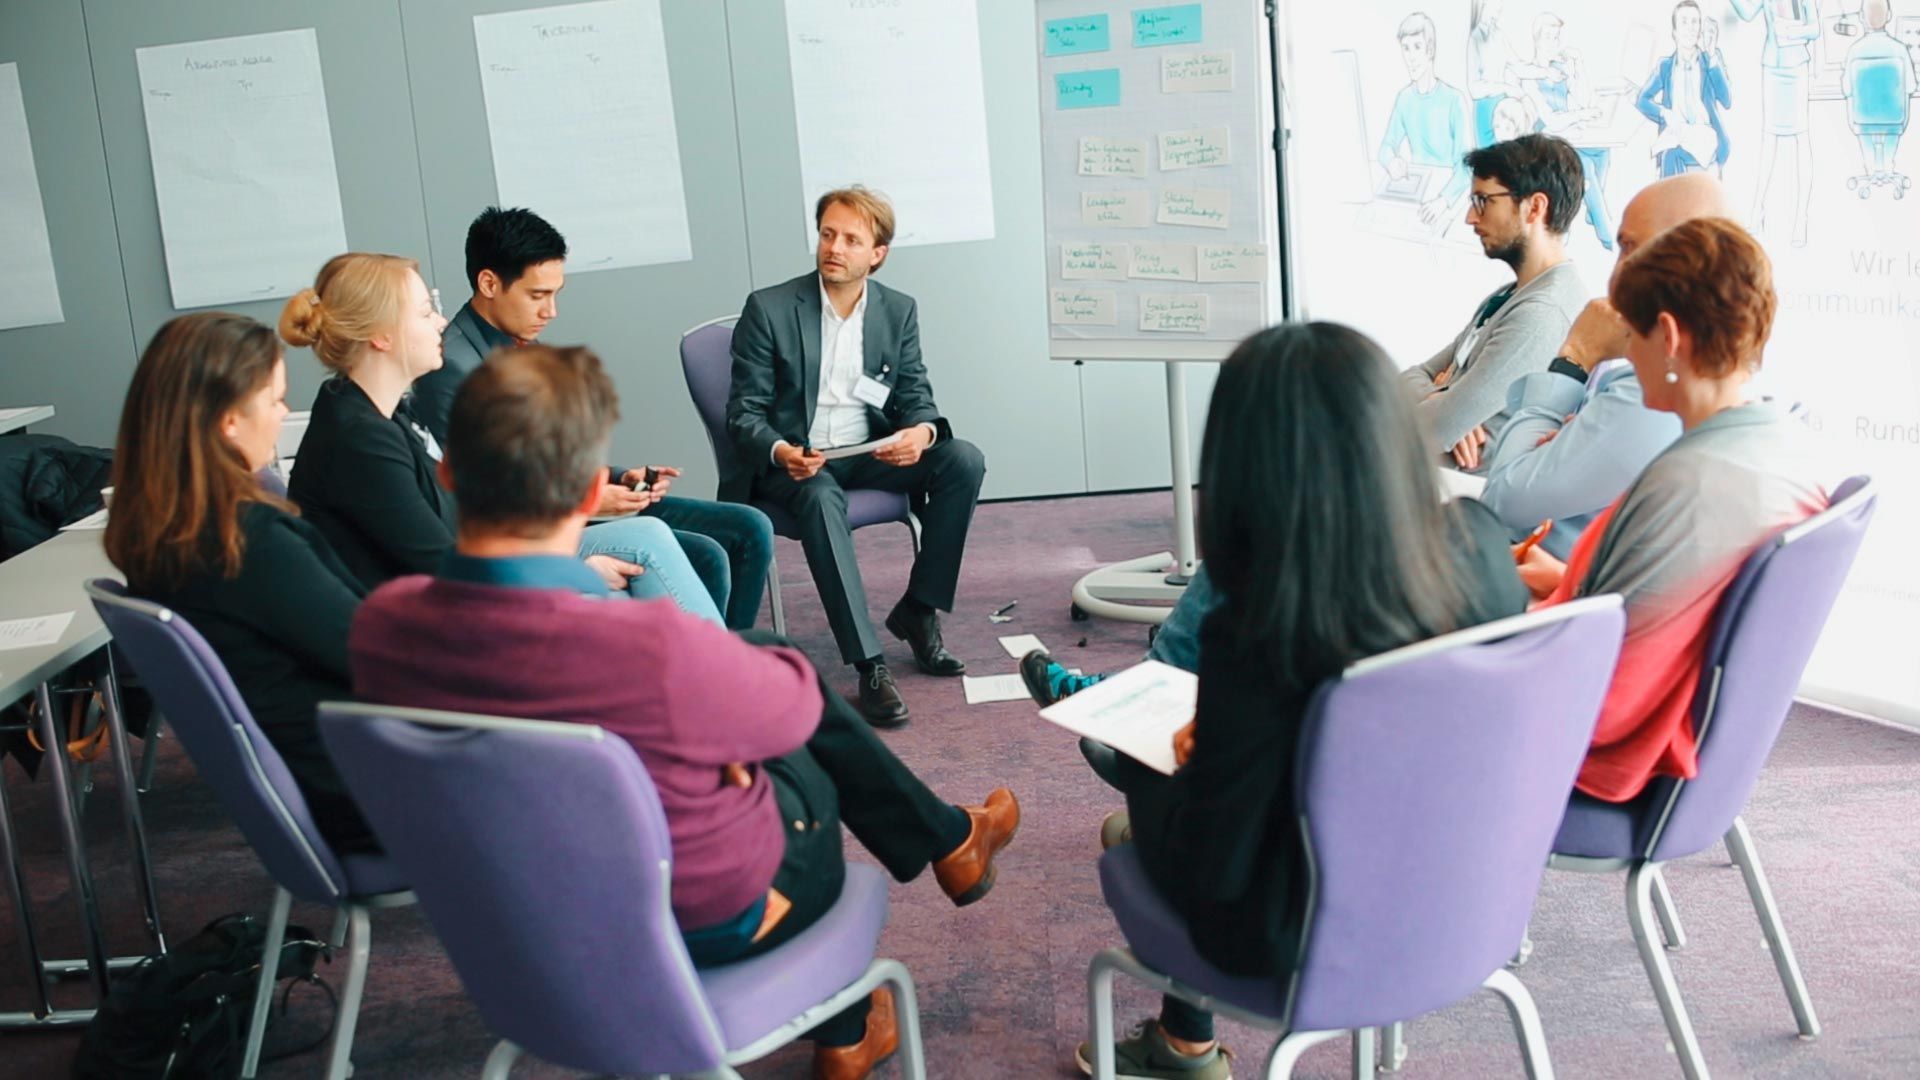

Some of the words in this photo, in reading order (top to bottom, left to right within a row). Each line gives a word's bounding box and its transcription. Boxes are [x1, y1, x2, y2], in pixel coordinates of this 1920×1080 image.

[1850, 250, 1896, 276] Wir
[1781, 290, 1920, 320] ommunika
[1855, 415, 1920, 446] Rund
